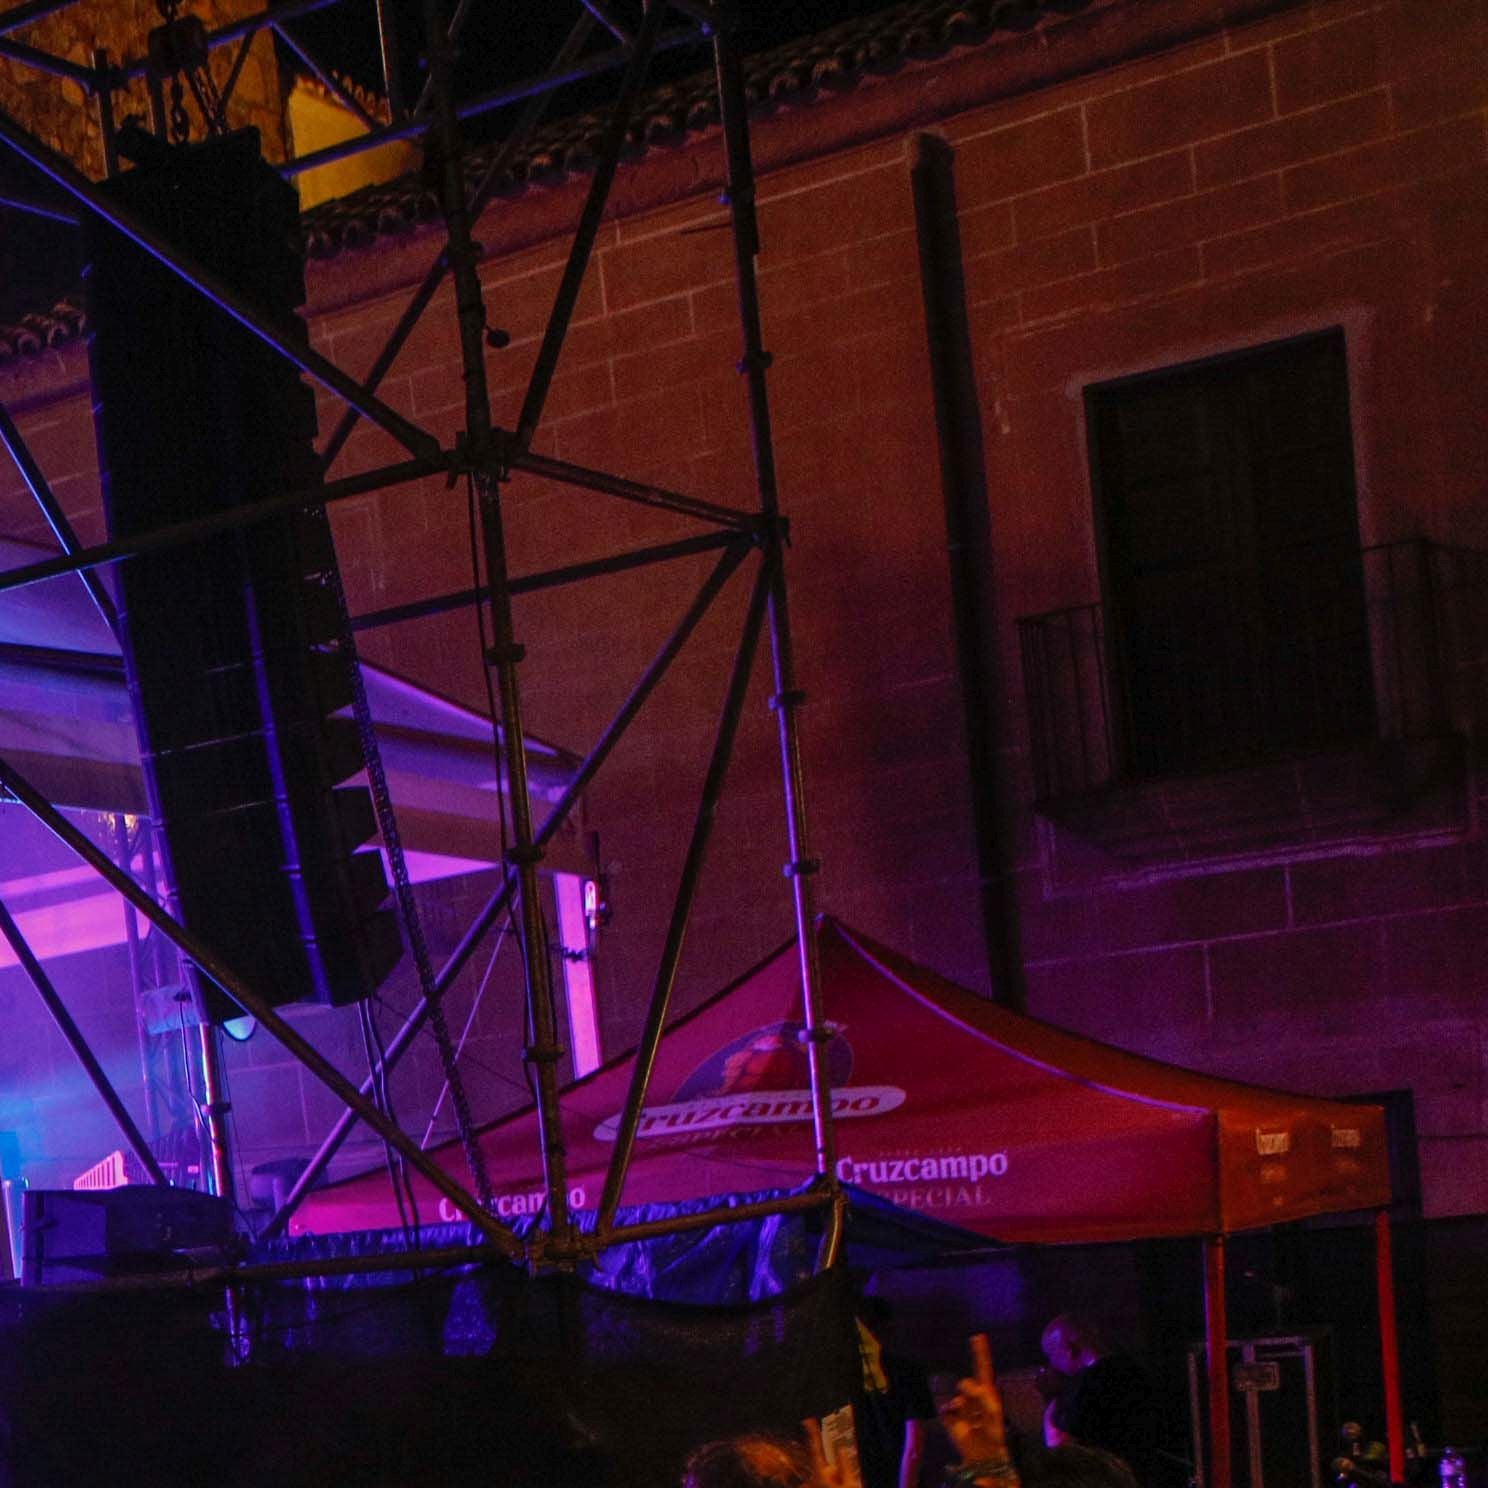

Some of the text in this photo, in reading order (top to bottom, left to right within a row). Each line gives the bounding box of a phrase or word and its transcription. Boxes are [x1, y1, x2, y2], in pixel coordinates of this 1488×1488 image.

[633, 1096, 881, 1132] ruzcamo
[835, 1152, 1008, 1184] Cruzcampo
[438, 1187, 586, 1223] Ccamo
